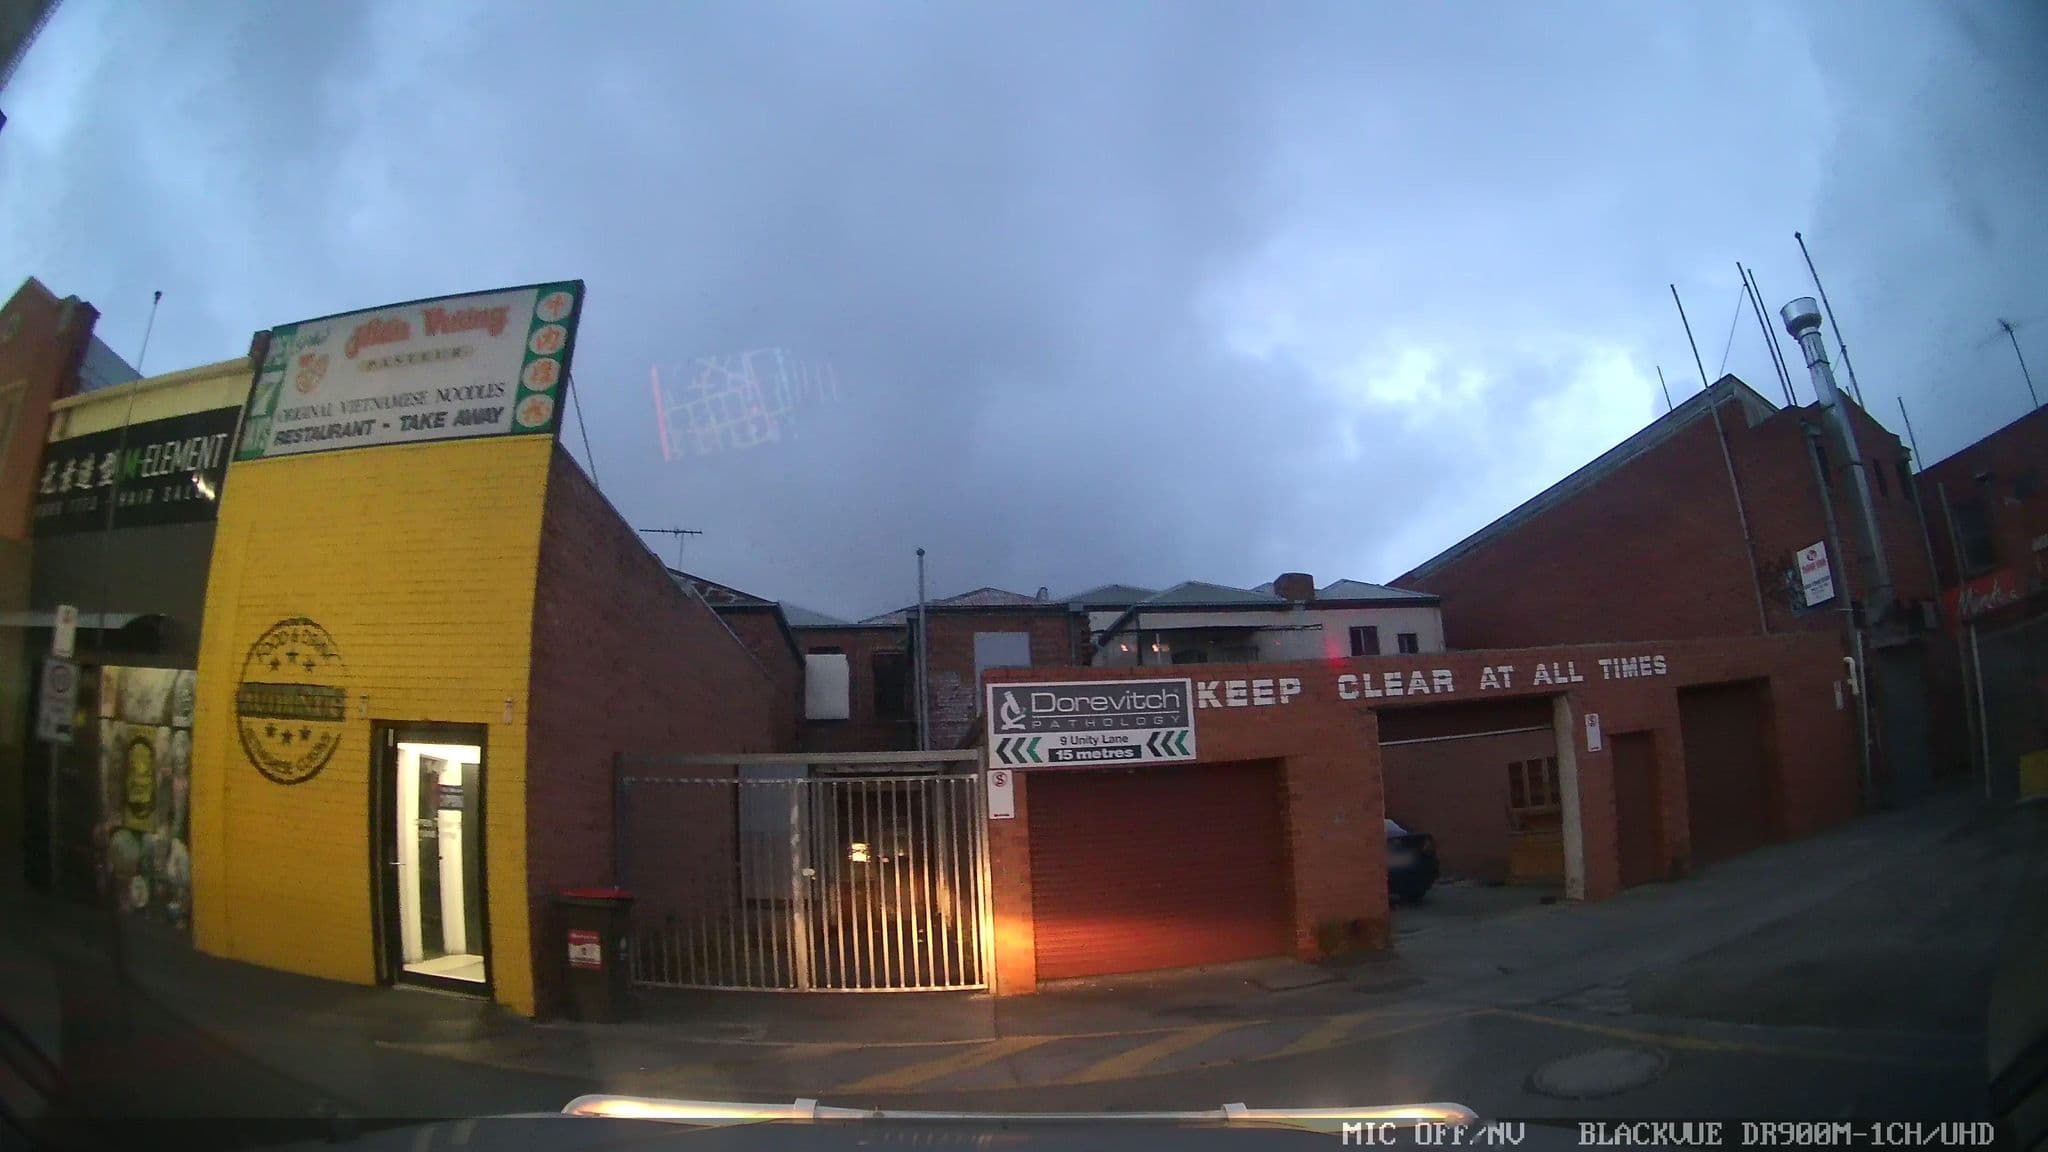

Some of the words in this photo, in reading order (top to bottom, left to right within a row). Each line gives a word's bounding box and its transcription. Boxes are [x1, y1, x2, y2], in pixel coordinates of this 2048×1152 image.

[340, 391, 428, 414] VIETNAMESE
[437, 382, 505, 403] NOODLES
[274, 419, 376, 446] RESTAURANT
[399, 411, 449, 432] TAKE
[453, 406, 505, 427] AWAY
[1198, 677, 1301, 709] KEEP
[1337, 668, 1455, 701] CLEAR
[1479, 664, 1514, 691] AT
[1533, 660, 1585, 686] ALL
[1599, 655, 1667, 680] TIMES
[1031, 688, 1180, 713] Dorevitch
[1031, 715, 1181, 729] PATHOLOGY
[1059, 735, 1067, 746] 9
[1070, 735, 1099, 747] Unity
[1102, 734, 1129, 744] Lane
[1056, 749, 1073, 761] 15
[1076, 748, 1134, 761] metres
